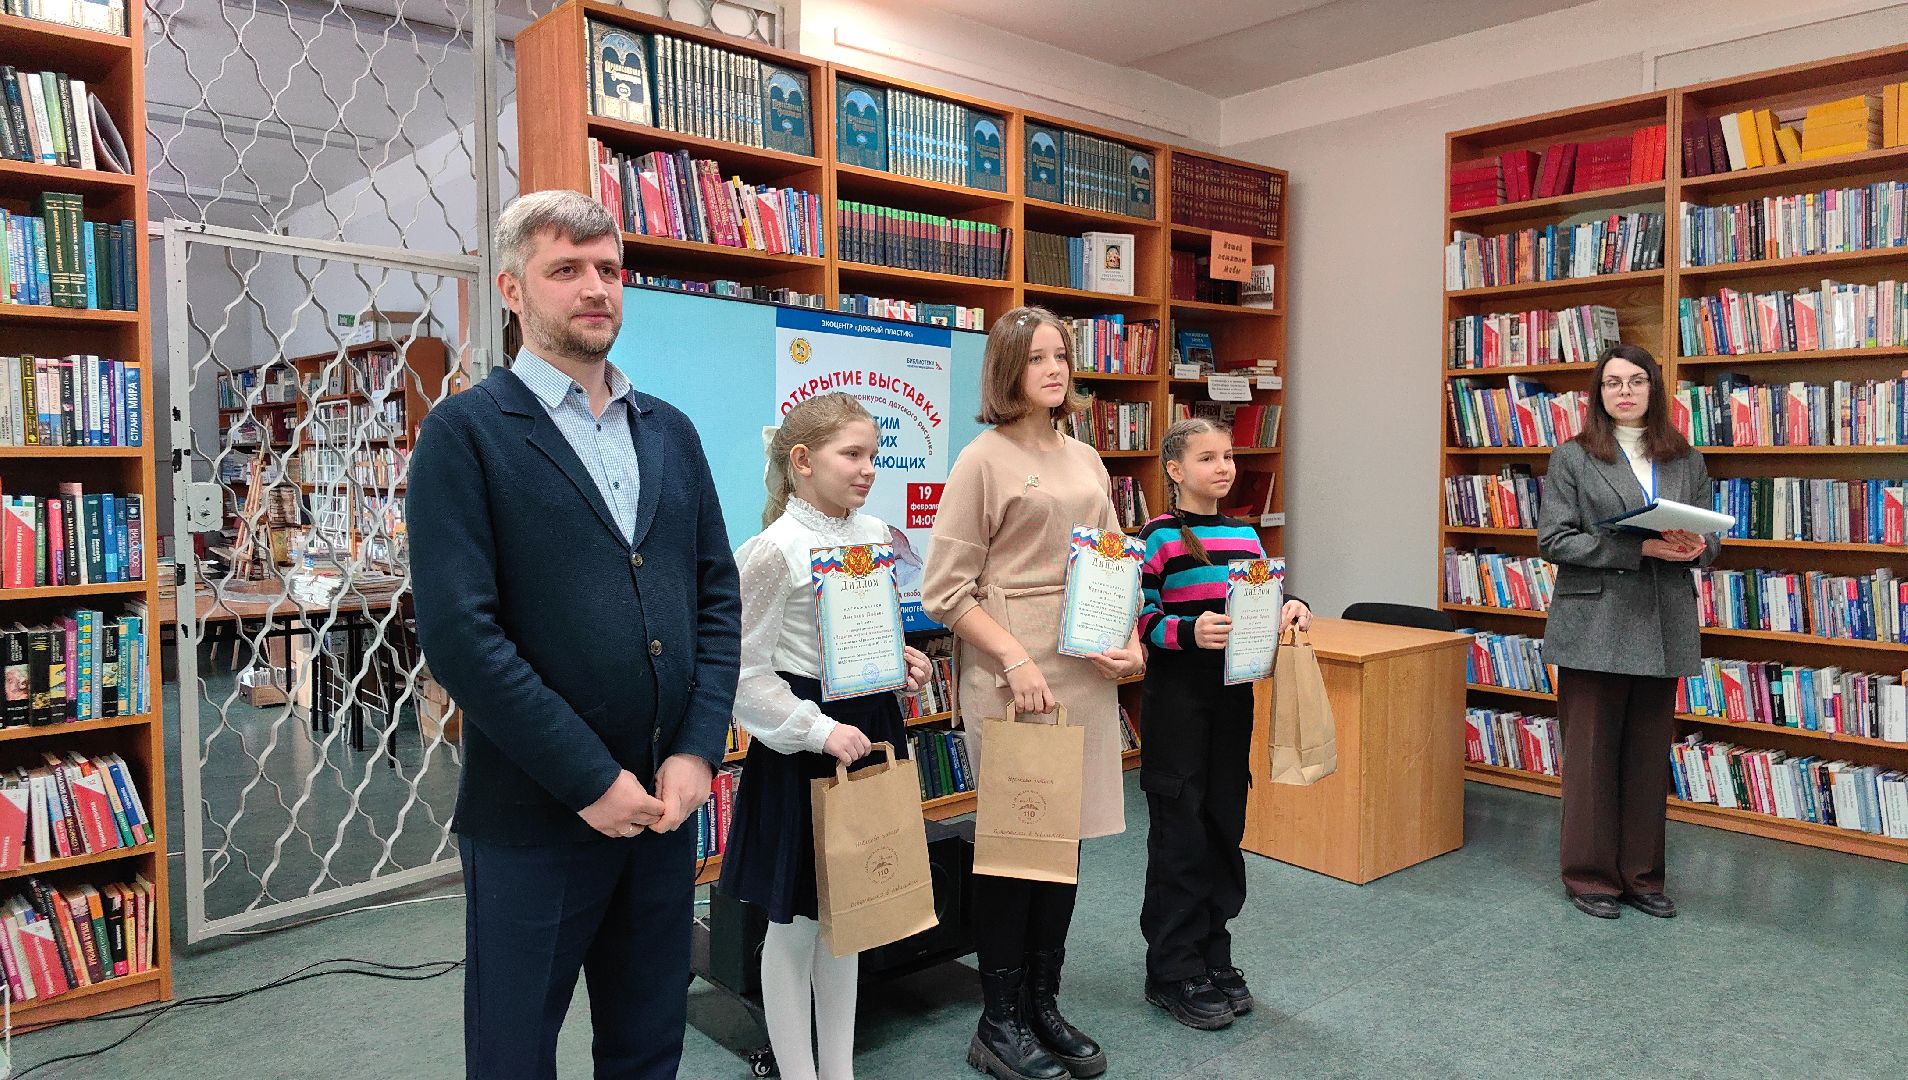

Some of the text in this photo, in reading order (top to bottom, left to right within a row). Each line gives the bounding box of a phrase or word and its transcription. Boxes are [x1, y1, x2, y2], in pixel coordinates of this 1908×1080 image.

[822, 320, 914, 338] ЭКОЦЕНТР «ДОБРЫЙ ПЛАСТИК»
[780, 370, 942, 428] ОТКРЫТИЕ ВЫСТАВКИ
[127, 382, 139, 440] СТРАНЫ МИРА
[873, 416, 900, 430] ТИМ
[874, 456, 926, 472] АЮЩИХ
[918, 485, 932, 500] 19
[912, 515, 936, 526] 14:00
[1092, 558, 1126, 574] ДИПЛОМ
[840, 580, 879, 592] ДИПЛОМ
[900, 606, 923, 614] ЛИОТЕК
[877, 868, 889, 878] 110
